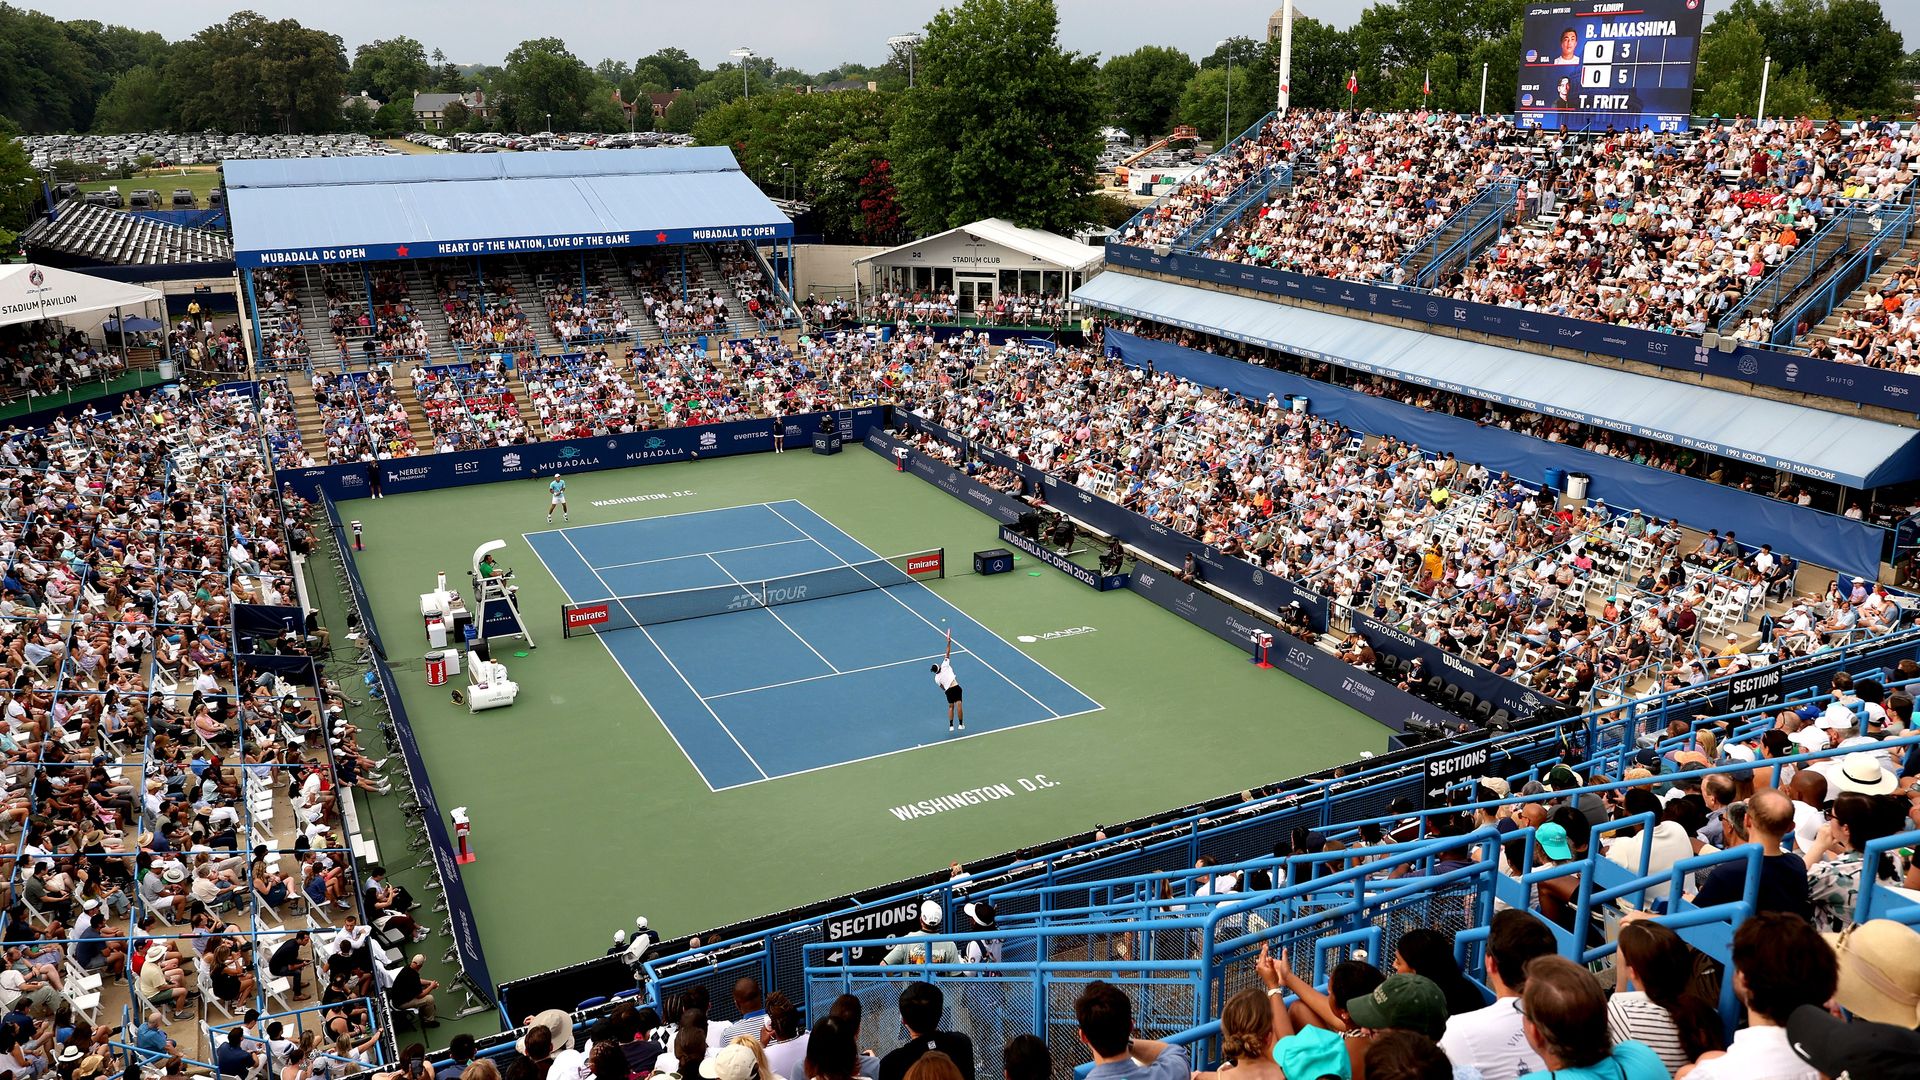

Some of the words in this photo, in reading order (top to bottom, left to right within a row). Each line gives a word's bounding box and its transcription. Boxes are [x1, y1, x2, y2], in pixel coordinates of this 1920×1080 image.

[1593, 3, 1624, 12] STADIUM
[1585, 24, 1598, 38] B.
[1600, 20, 1677, 38] NAKASHIMA
[1596, 44, 1603, 58] 0
[1622, 44, 1630, 58] 3
[1593, 70, 1601, 84] 0
[1618, 70, 1628, 84] 5
[1579, 95, 1590, 109] T.
[1593, 95, 1630, 110] FRITZ
[693, 228, 738, 239] MUBADALA
[741, 228, 752, 236] DC
[754, 227, 775, 236] OPEN
[438, 242, 469, 253] HEART
[472, 242, 485, 252] OF
[486, 241, 505, 251] THE
[507, 239, 545, 250] NATION,
[547, 237, 570, 247] LOVE
[572, 236, 584, 246] OF
[586, 235, 603, 245] THE
[605, 234, 630, 244] GAME
[261, 252, 319, 263] MUBADALA
[323, 250, 336, 260] DC
[339, 248, 366, 258] OPEN
[2, 301, 39, 314] STADIUM
[41, 295, 77, 308] PAVILION
[1558, 328, 1572, 337] EGA
[1602, 336, 1626, 345] waterdrop
[1648, 342, 1668, 351] EQT
[1414, 376, 1432, 385] GOMEZ
[1478, 391, 1502, 401] NOVACEK
[1884, 386, 1908, 395] LOBOS
[1520, 400, 1537, 409] LENDL
[1555, 409, 1584, 420] CONNORS
[1604, 420, 1632, 432] MAYOTTE
[1638, 427, 1652, 437] 1990
[1653, 431, 1674, 442] AGASSI
[1681, 437, 1694, 447] 1991
[1696, 441, 1718, 452] AGASSI
[627, 448, 683, 460] MUBADALA
[1725, 448, 1740, 458] 1992
[1742, 452, 1767, 464] KORDA
[455, 461, 478, 470] EQT
[540, 457, 599, 470] MUBADALA
[1776, 460, 1791, 471] 1993
[1793, 464, 1836, 480] MANSDORF
[399, 467, 428, 476] NEREUS
[968, 488, 993, 506] waterdrop
[908, 558, 939, 570] Emirates
[1004, 530, 1041, 558] MUBADALA
[1042, 552, 1052, 563] DC
[1053, 557, 1073, 575] OPEN
[1074, 567, 1094, 585] 2026
[1140, 574, 1155, 585] NRF
[727, 592, 760, 609] ATP
[767, 585, 808, 604] TOUR
[1293, 587, 1318, 604] SEATGEEK
[570, 609, 606, 622] Emirates
[1034, 626, 1098, 639] VANDA
[1232, 620, 1252, 635] Insperi
[1363, 619, 1416, 647] ATPTOUR.COM
[1288, 647, 1313, 665] EQT
[1443, 653, 1475, 677] Wilson
[1354, 681, 1375, 697] TENNIS
[1733, 671, 1779, 694] SECTIONS
[1351, 688, 1373, 702] Channel
[1744, 697, 1756, 711] 7A
[1762, 694, 1768, 705] 7
[1430, 749, 1486, 777] SECTIONS
[889, 783, 1015, 821] WASHINGTON
[1017, 774, 1061, 791] D.C.
[830, 903, 918, 940] SECTIONS
